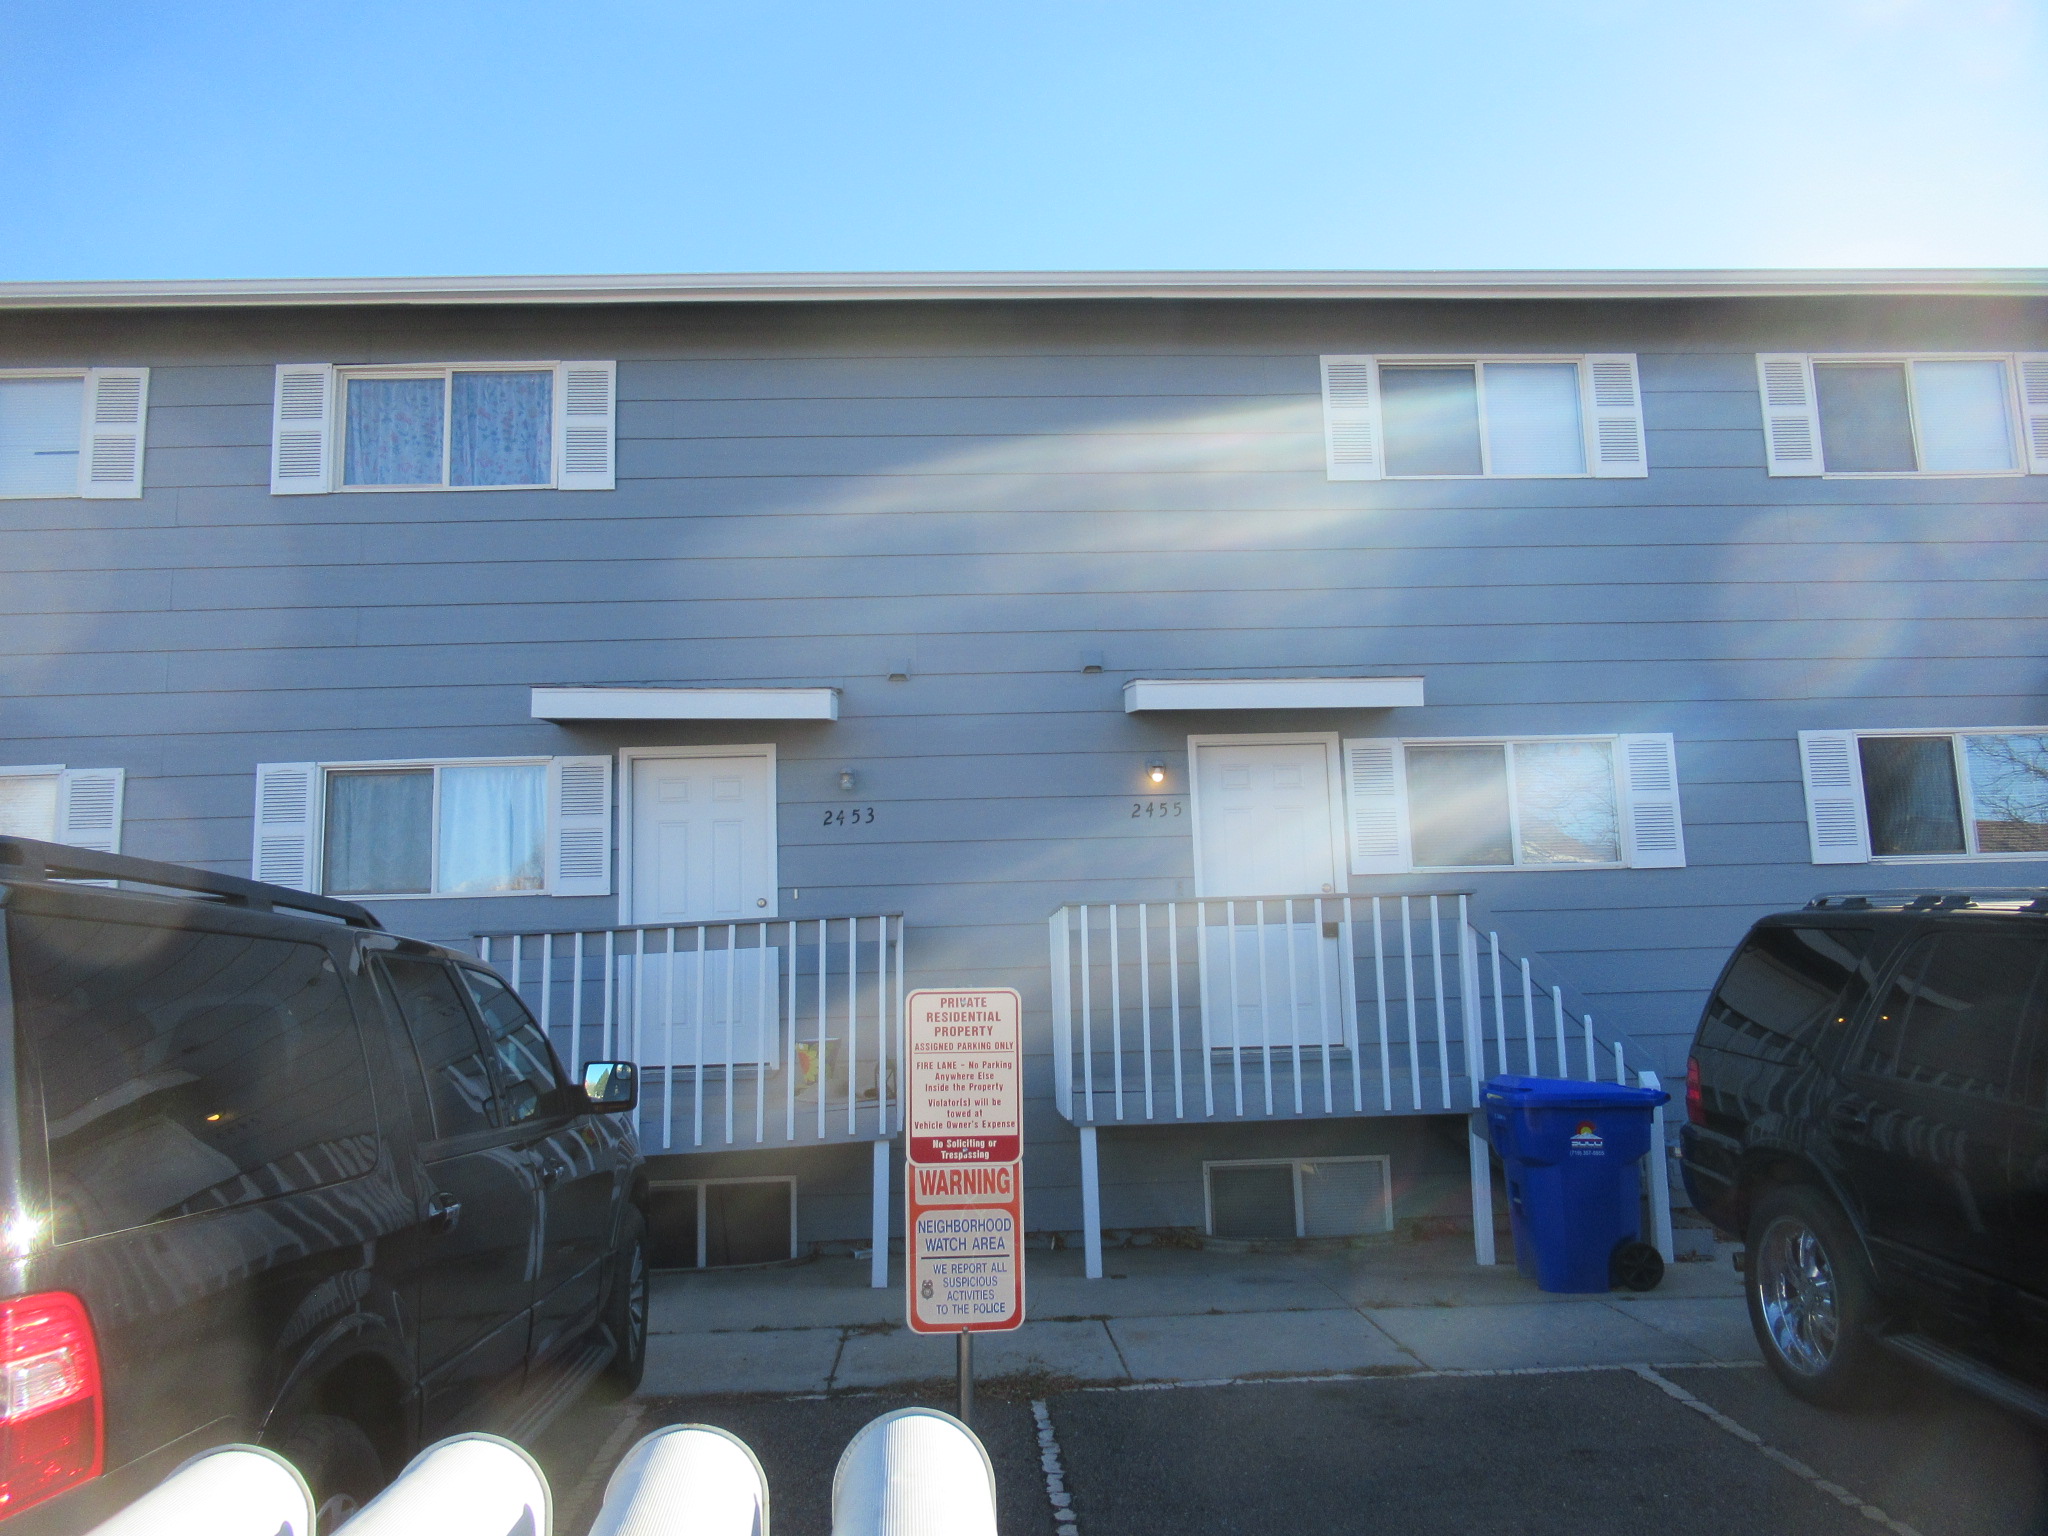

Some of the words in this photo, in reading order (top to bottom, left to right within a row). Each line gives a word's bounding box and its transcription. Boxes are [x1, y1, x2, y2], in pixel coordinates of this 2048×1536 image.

[1132, 802, 1182, 818] 2455
[824, 808, 874, 826] 2453
[941, 997, 987, 1008] PRIVATE
[926, 1012, 1001, 1022] RESIDENTIAL
[935, 1026, 993, 1037] PROPERTY
[915, 1042, 954, 1051] ASSIGNED
[958, 1042, 991, 1050] PARKING
[995, 1042, 1014, 1050] ONLY
[917, 1062, 933, 1070] FIRE
[982, 1061, 1012, 1070] Parking
[935, 1073, 974, 1081] Anywhere
[969, 1083, 1004, 1092] Property
[928, 1098, 970, 1107] Violator(s)
[915, 1121, 942, 1129] Vehicle
[947, 1121, 978, 1129] Owner's
[982, 1120, 1015, 1129] Expense
[933, 1140, 943, 1148] No
[947, 1139, 985, 1148] Soliciting
[941, 1150, 990, 1160] Trespassing
[919, 1167, 1010, 1196] WARNING
[918, 1218, 1012, 1233] NEIGHBORHOOD
[926, 1237, 966, 1252] WATCH
[972, 1236, 1005, 1250] AREA
[933, 1264, 947, 1274] WE
[952, 1263, 987, 1274] REPORT
[991, 1263, 1007, 1272] ALL
[943, 1276, 998, 1288] SUSPICIOUS
[947, 1290, 995, 1300] ACTIVITIES
[936, 1305, 948, 1314] TO
[952, 1304, 969, 1314] THE
[974, 1303, 1005, 1313] POLICE
